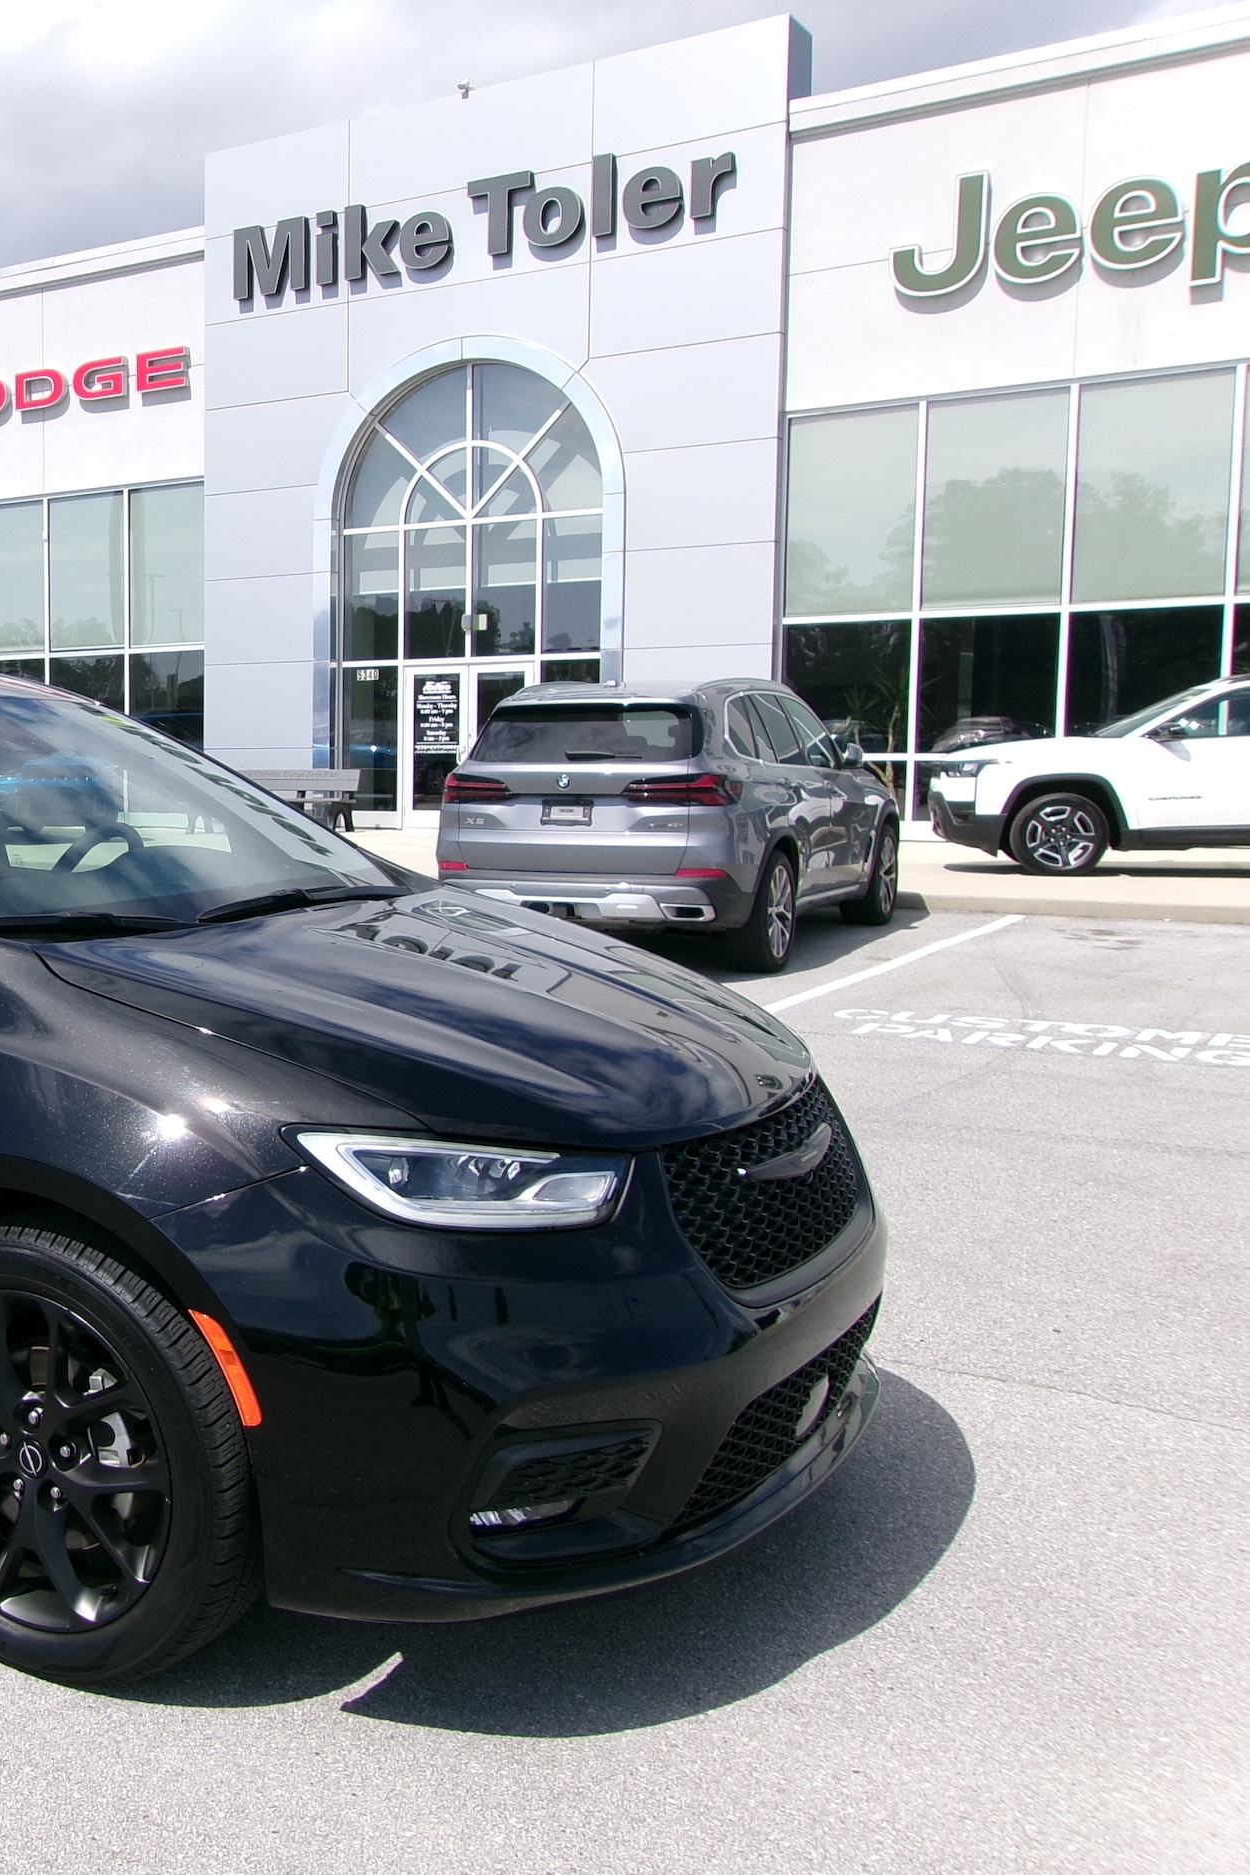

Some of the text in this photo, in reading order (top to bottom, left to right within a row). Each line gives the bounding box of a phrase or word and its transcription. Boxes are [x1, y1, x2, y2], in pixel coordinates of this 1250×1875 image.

[232, 150, 736, 301] Mike Toler
[889, 161, 1250, 298] Jeep
[358, 669, 378, 680] 5340
[465, 817, 485, 825] X5
[851, 1022, 1250, 1067] PARKING
